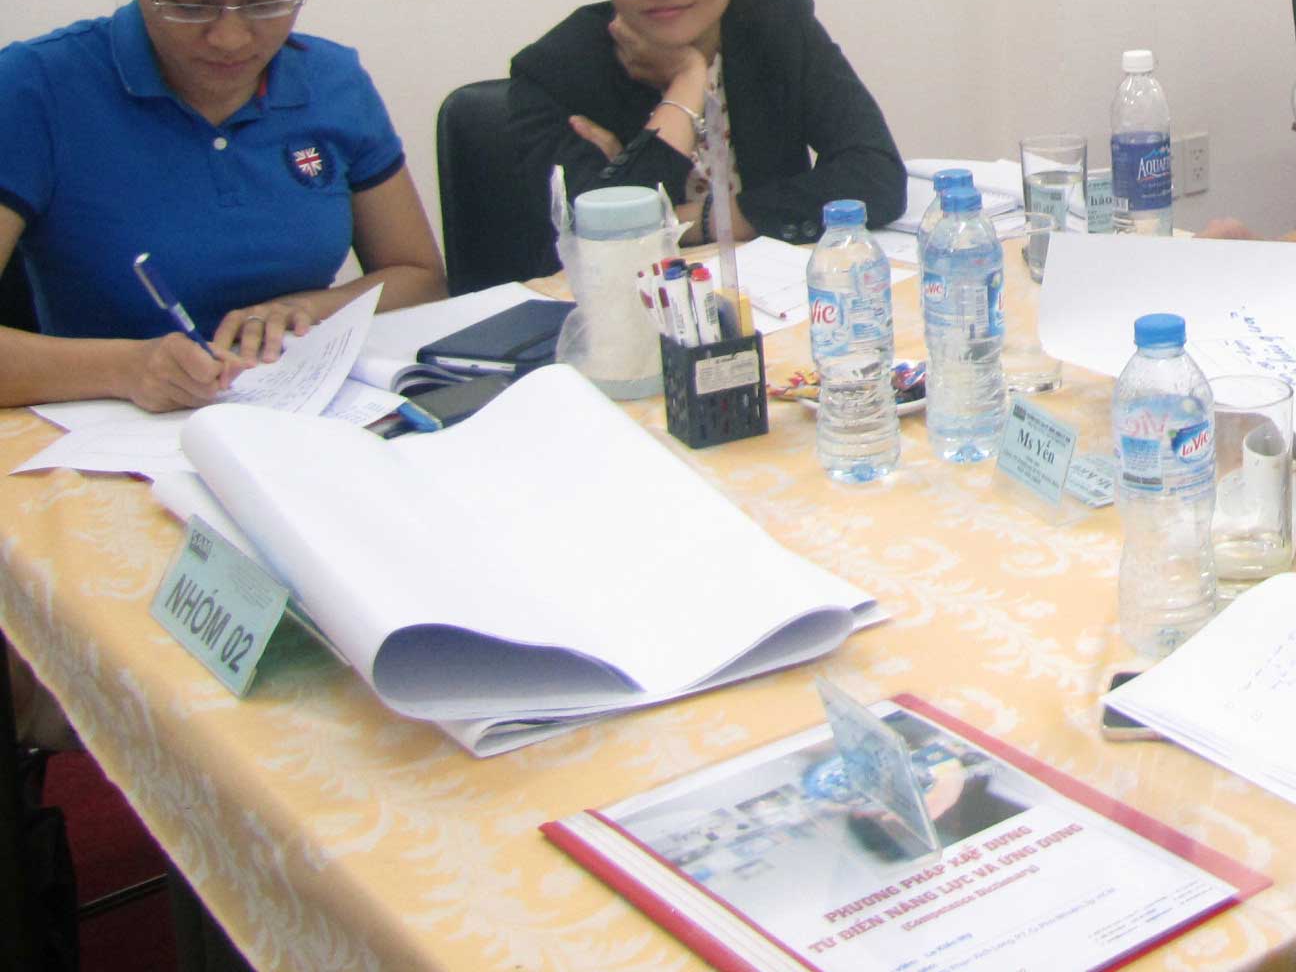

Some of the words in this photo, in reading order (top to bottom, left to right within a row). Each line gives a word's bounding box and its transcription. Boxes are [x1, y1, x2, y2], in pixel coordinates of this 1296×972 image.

[1017, 428, 1033, 450] Ms
[164, 573, 232, 650] NHÓM
[220, 625, 254, 674] 02
